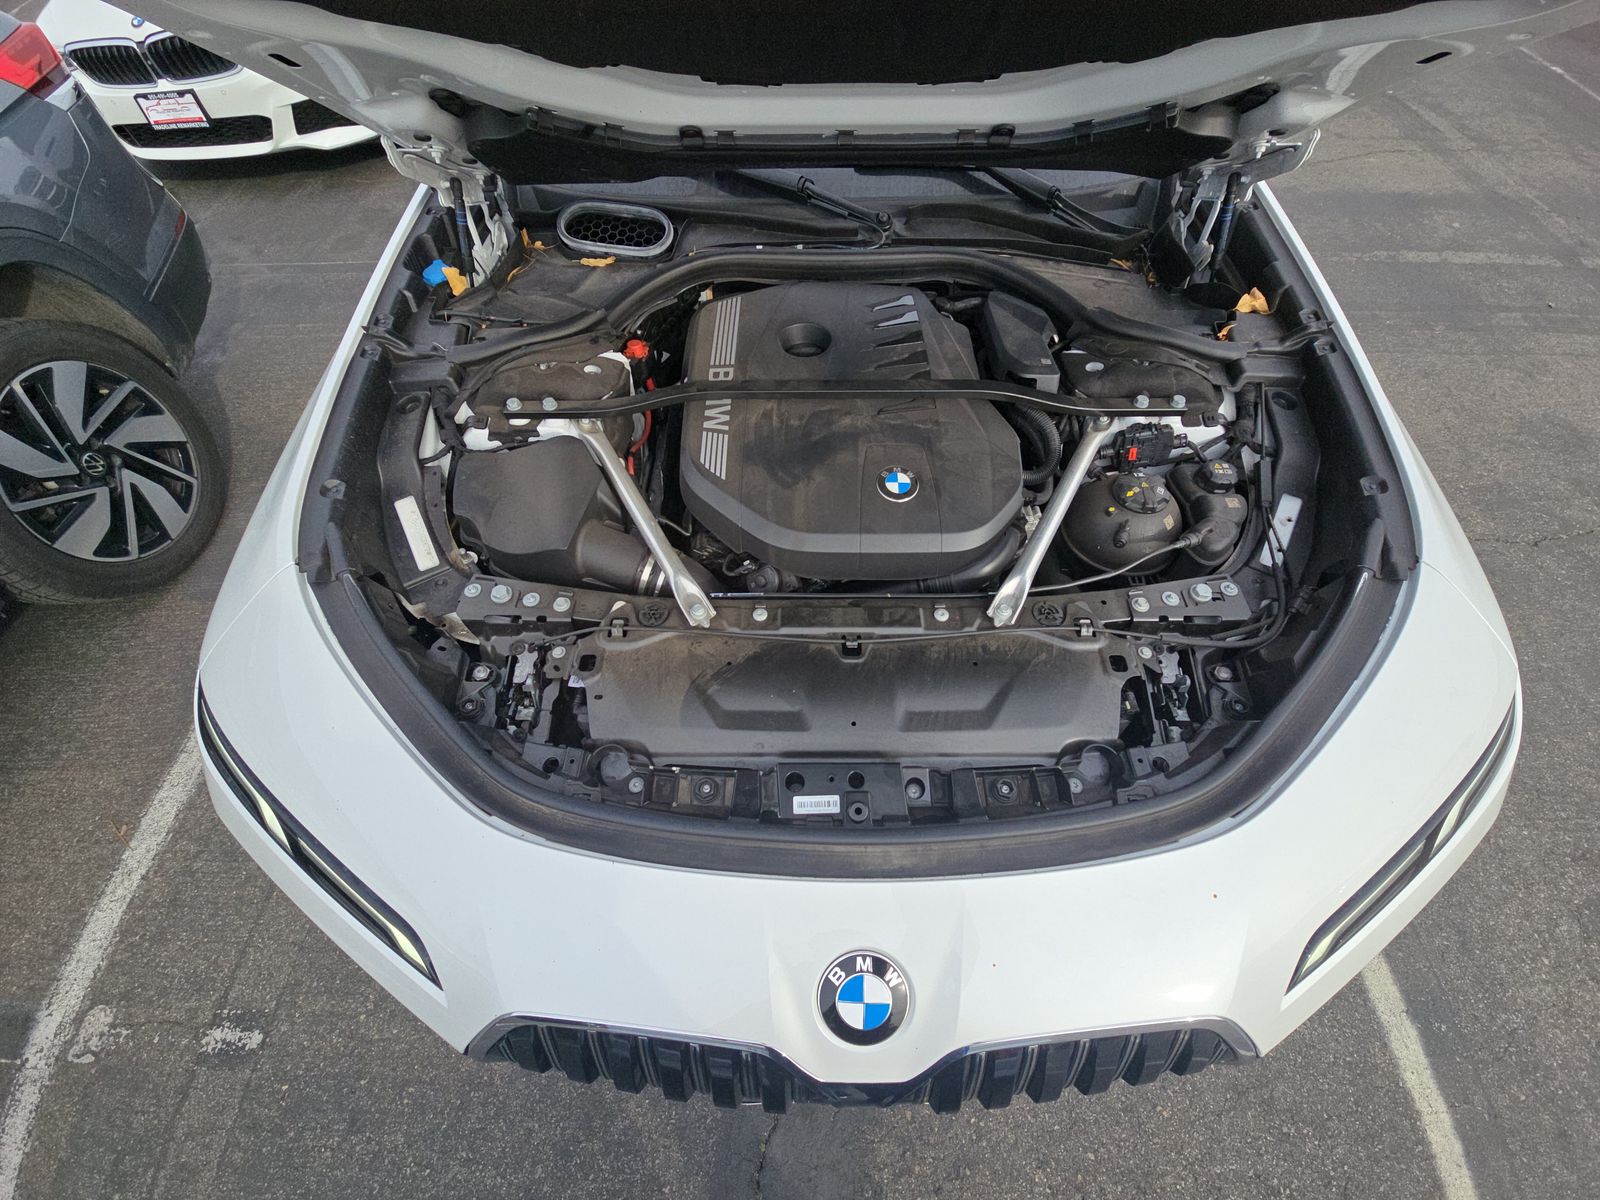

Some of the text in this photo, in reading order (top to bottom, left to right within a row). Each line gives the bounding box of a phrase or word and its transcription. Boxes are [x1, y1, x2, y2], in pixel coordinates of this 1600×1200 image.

[703, 367, 734, 431] BW
[880, 467, 915, 478] BMW
[827, 956, 903, 987] BMW
